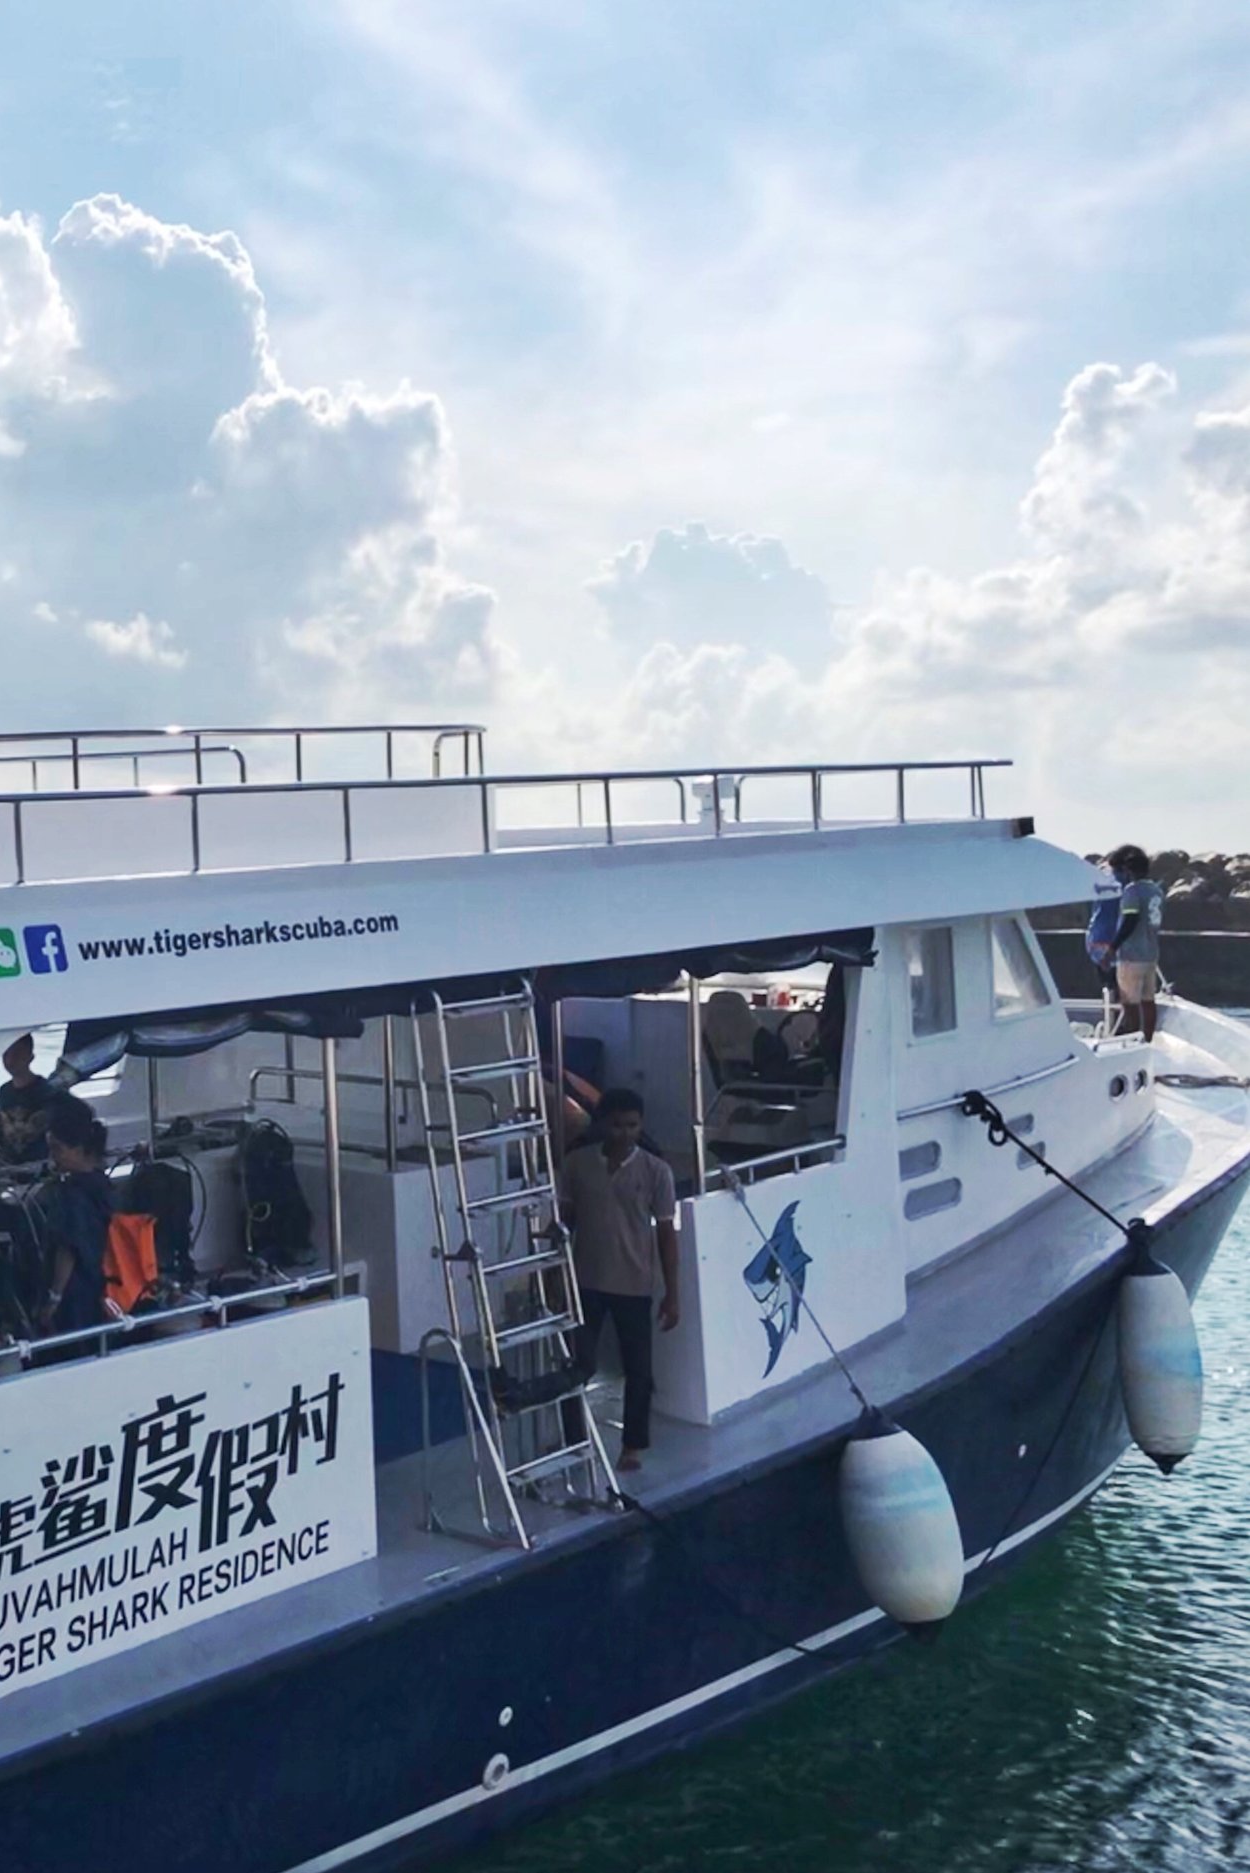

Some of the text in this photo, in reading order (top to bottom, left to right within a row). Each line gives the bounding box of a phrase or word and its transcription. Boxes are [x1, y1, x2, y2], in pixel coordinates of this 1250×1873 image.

[77, 914, 399, 961] www.tigersharkscuba.com
[66, 1582, 170, 1653] SHARK
[178, 1519, 330, 1610] RESIDENCE
